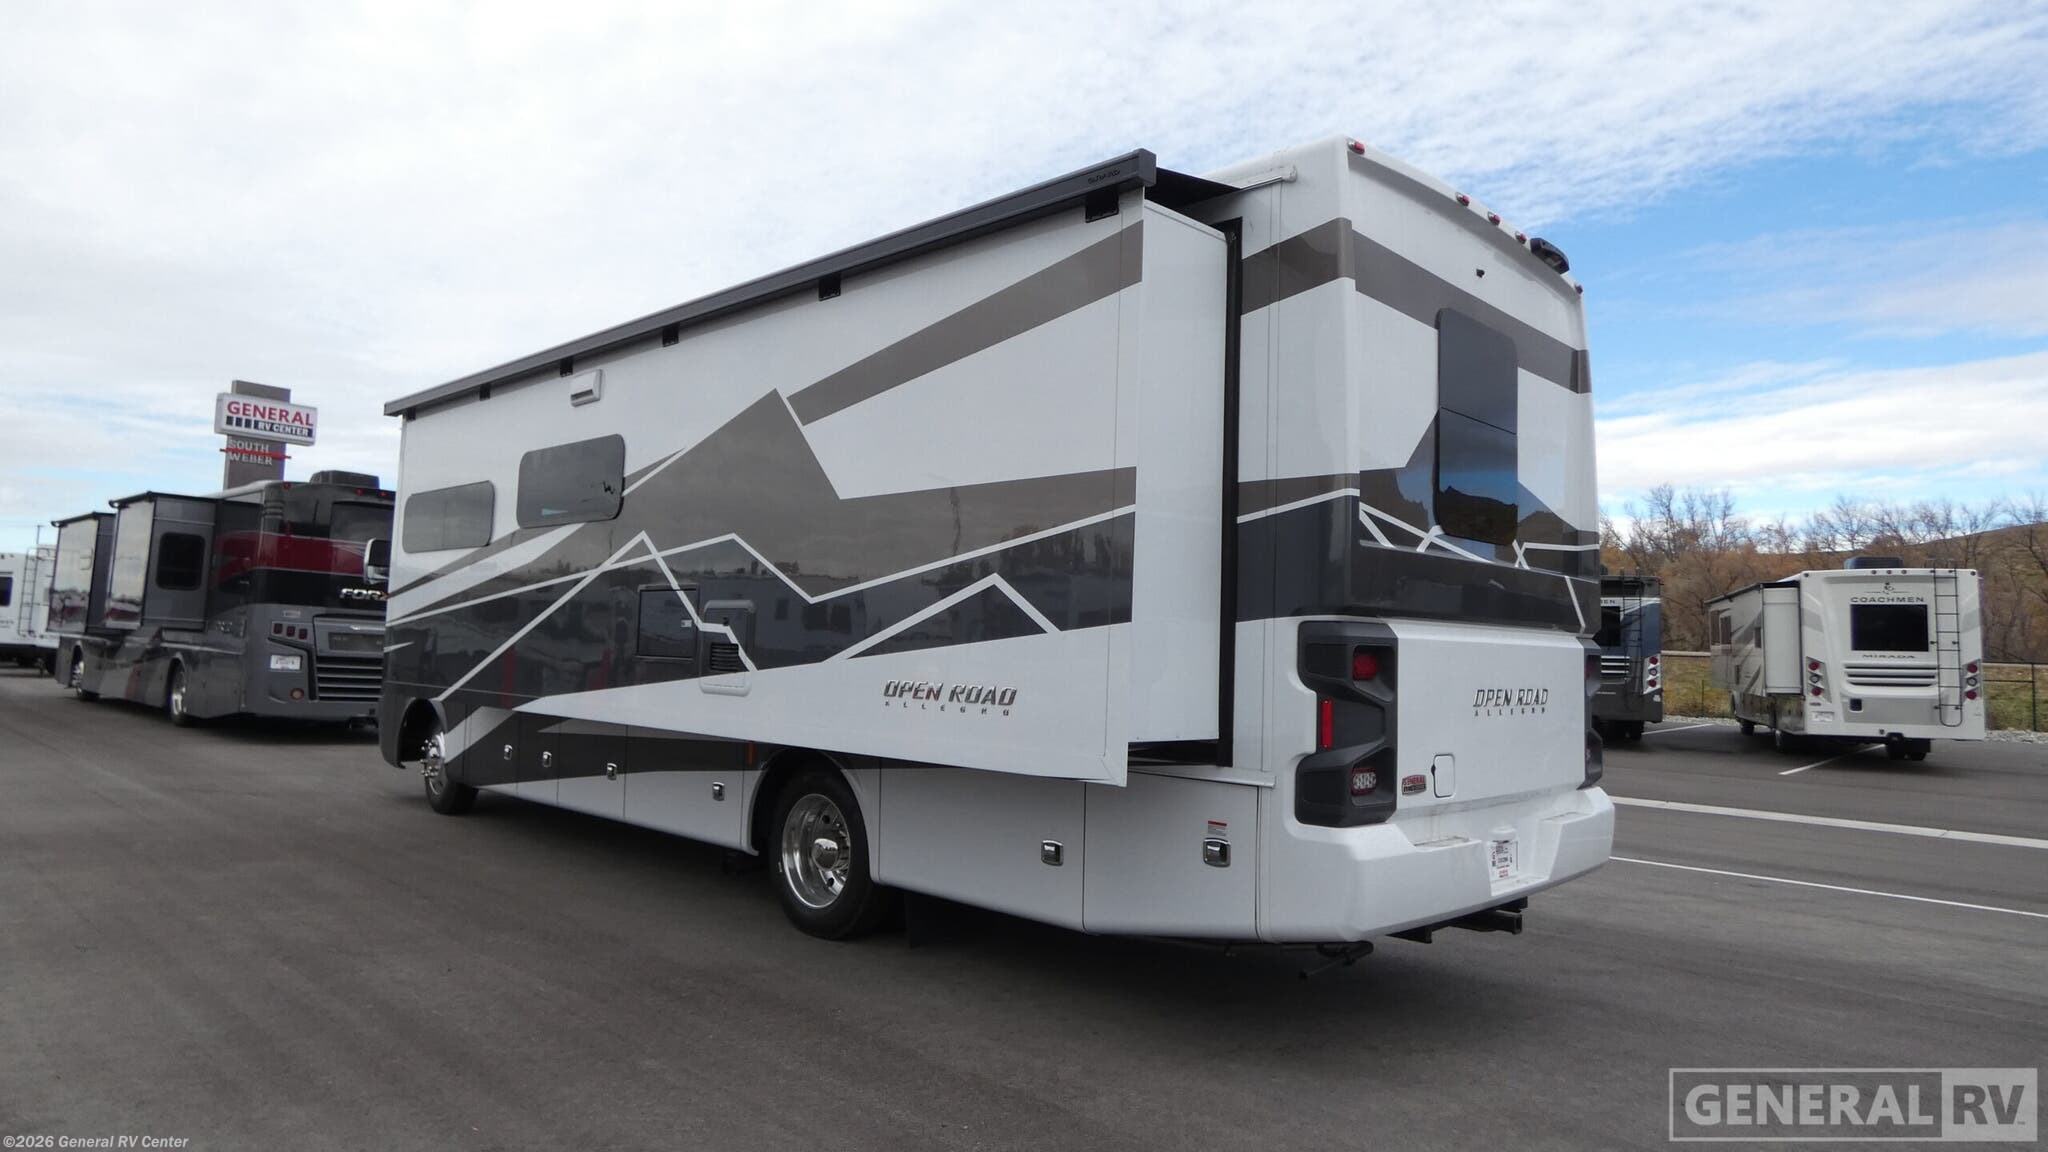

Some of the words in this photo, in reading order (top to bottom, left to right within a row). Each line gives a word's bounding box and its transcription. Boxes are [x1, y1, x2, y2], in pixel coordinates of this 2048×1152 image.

[227, 401, 314, 427] GENERAL
[259, 421, 272, 431] RV
[273, 424, 309, 437] CENTER
[229, 438, 270, 453] SOUTH
[231, 451, 273, 466] WEBER
[883, 680, 943, 701] OPEN
[948, 684, 1017, 706] ROAD
[1472, 688, 1513, 707] OPEN
[1516, 688, 1549, 706] ROAD
